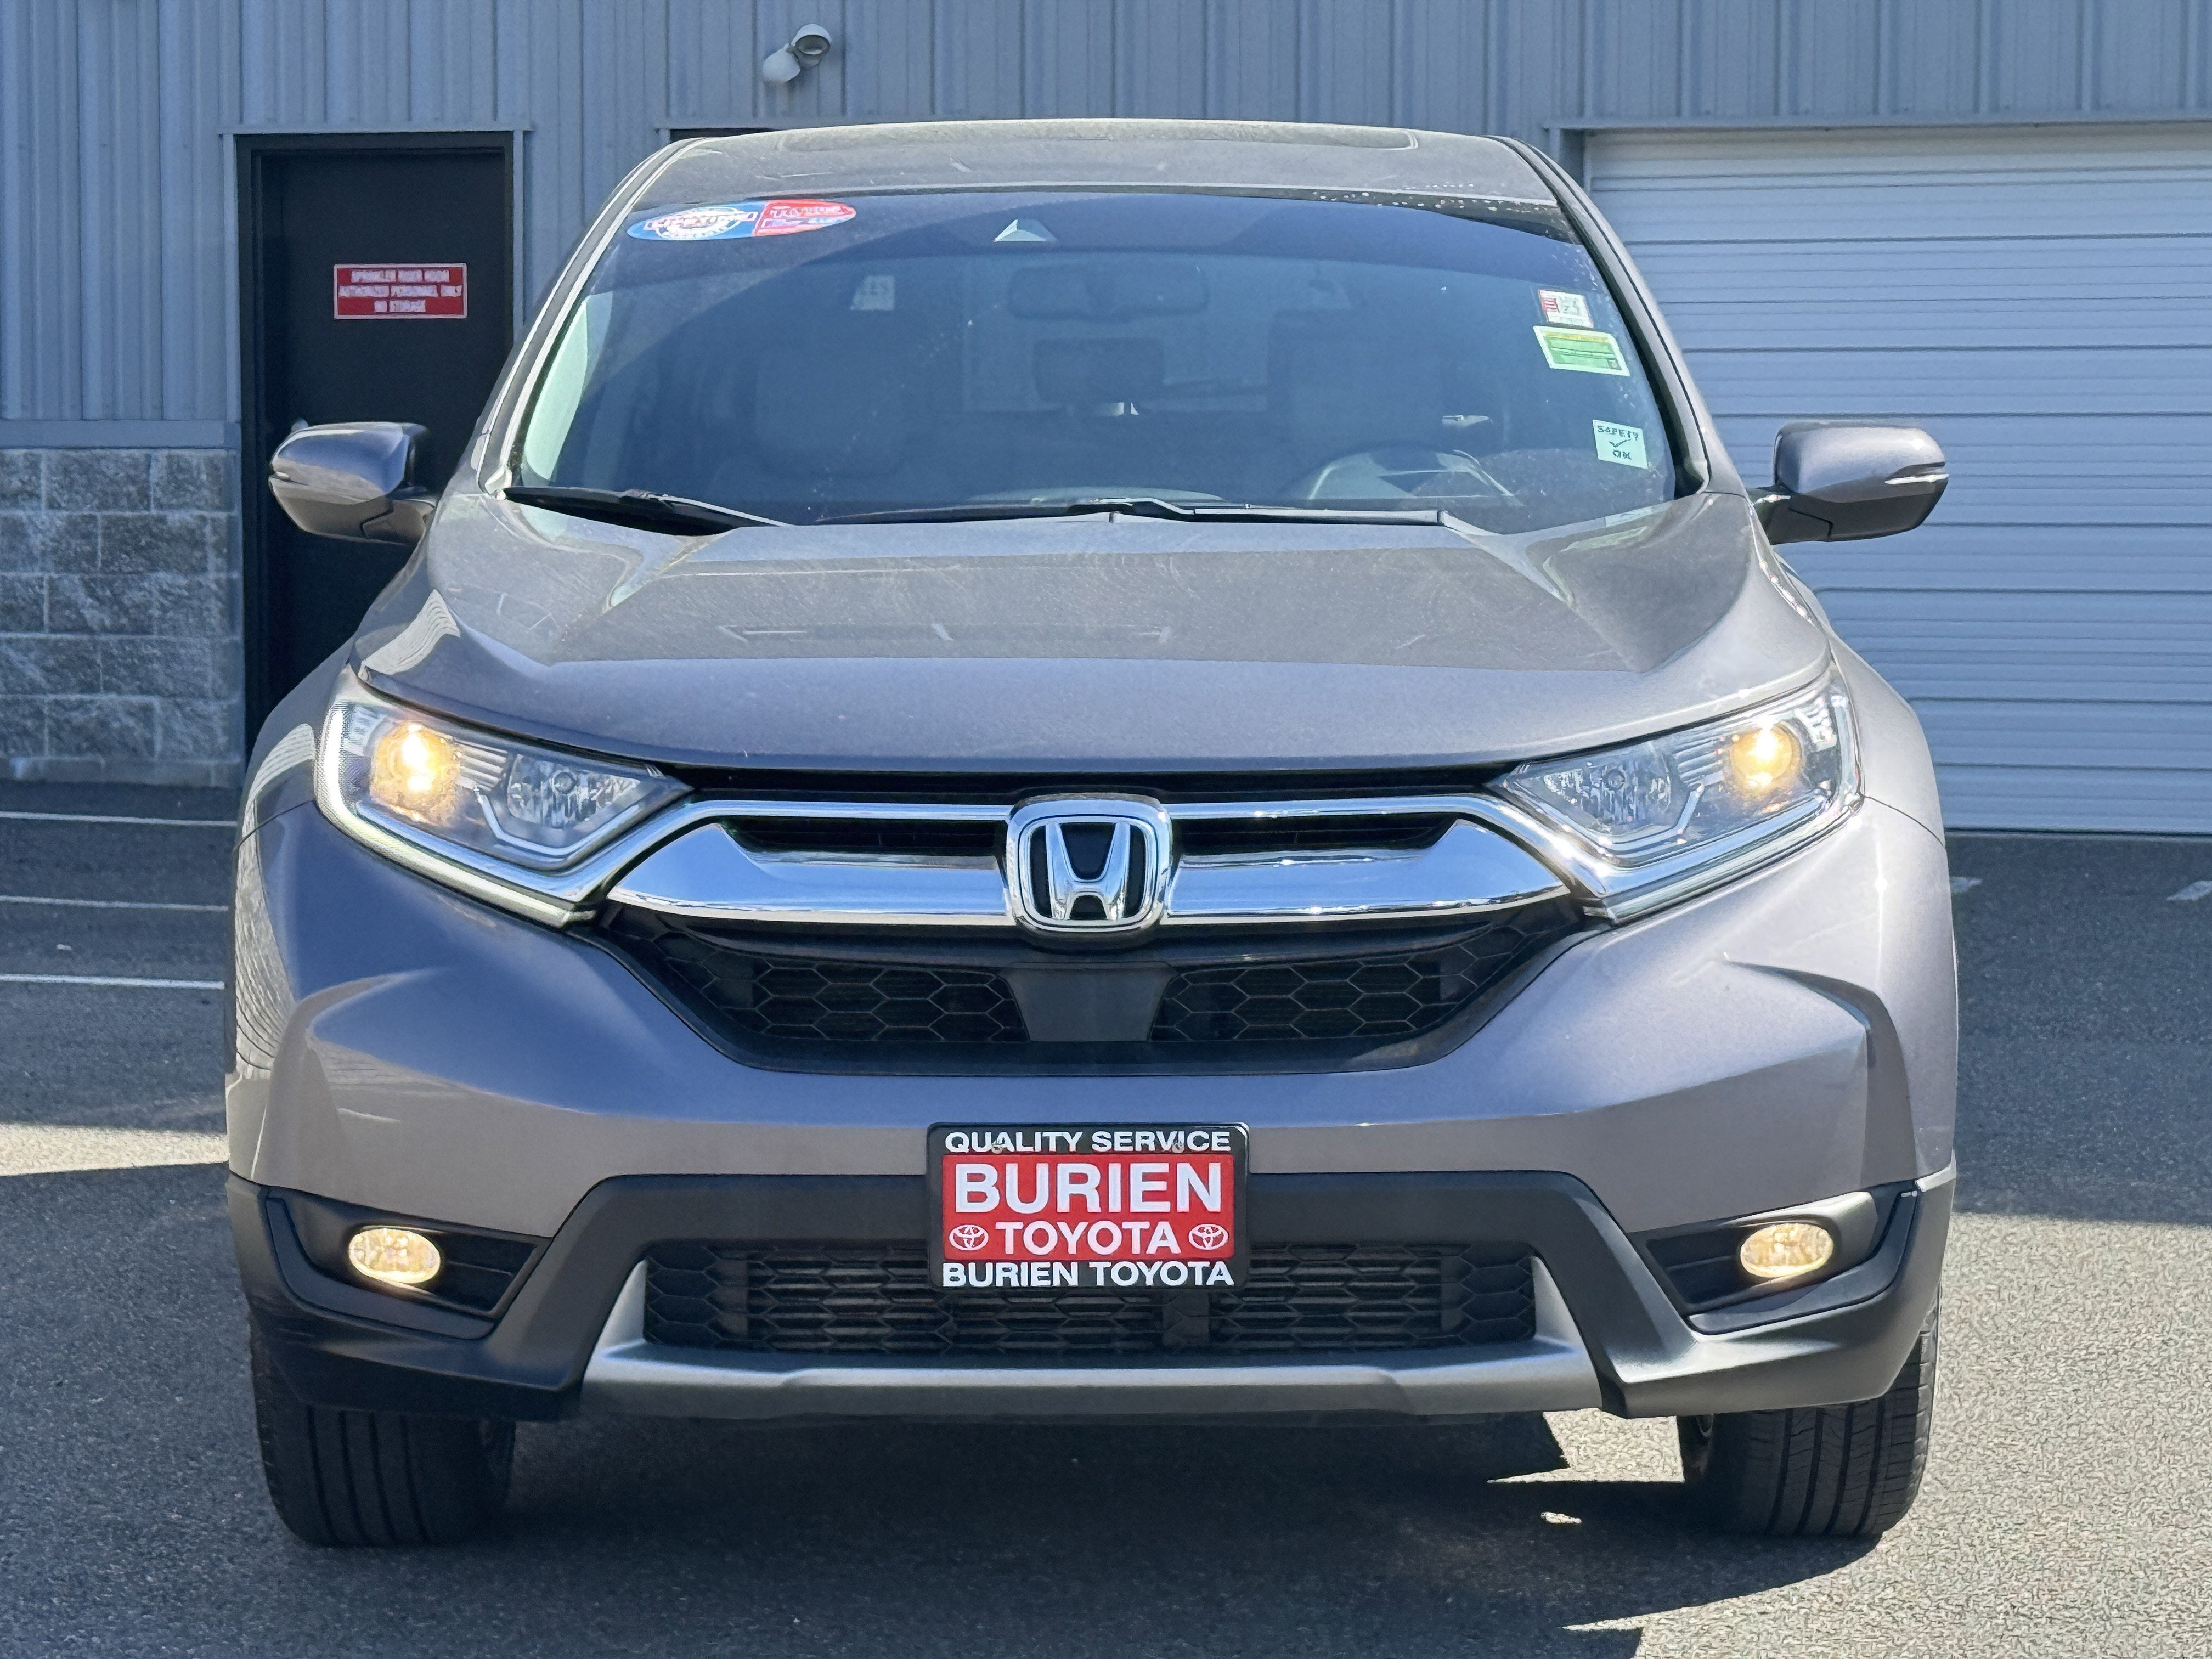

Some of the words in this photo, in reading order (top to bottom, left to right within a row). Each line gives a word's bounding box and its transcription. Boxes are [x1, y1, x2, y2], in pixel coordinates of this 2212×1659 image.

[944, 1131, 1084, 1154] QUALITY
[1091, 1130, 1232, 1154] SERVICE
[955, 1161, 1222, 1215] BURIEN
[995, 1220, 1182, 1256] TOYOTA
[942, 1261, 1079, 1288] BURIEN
[1088, 1260, 1235, 1287] TOYOTA
